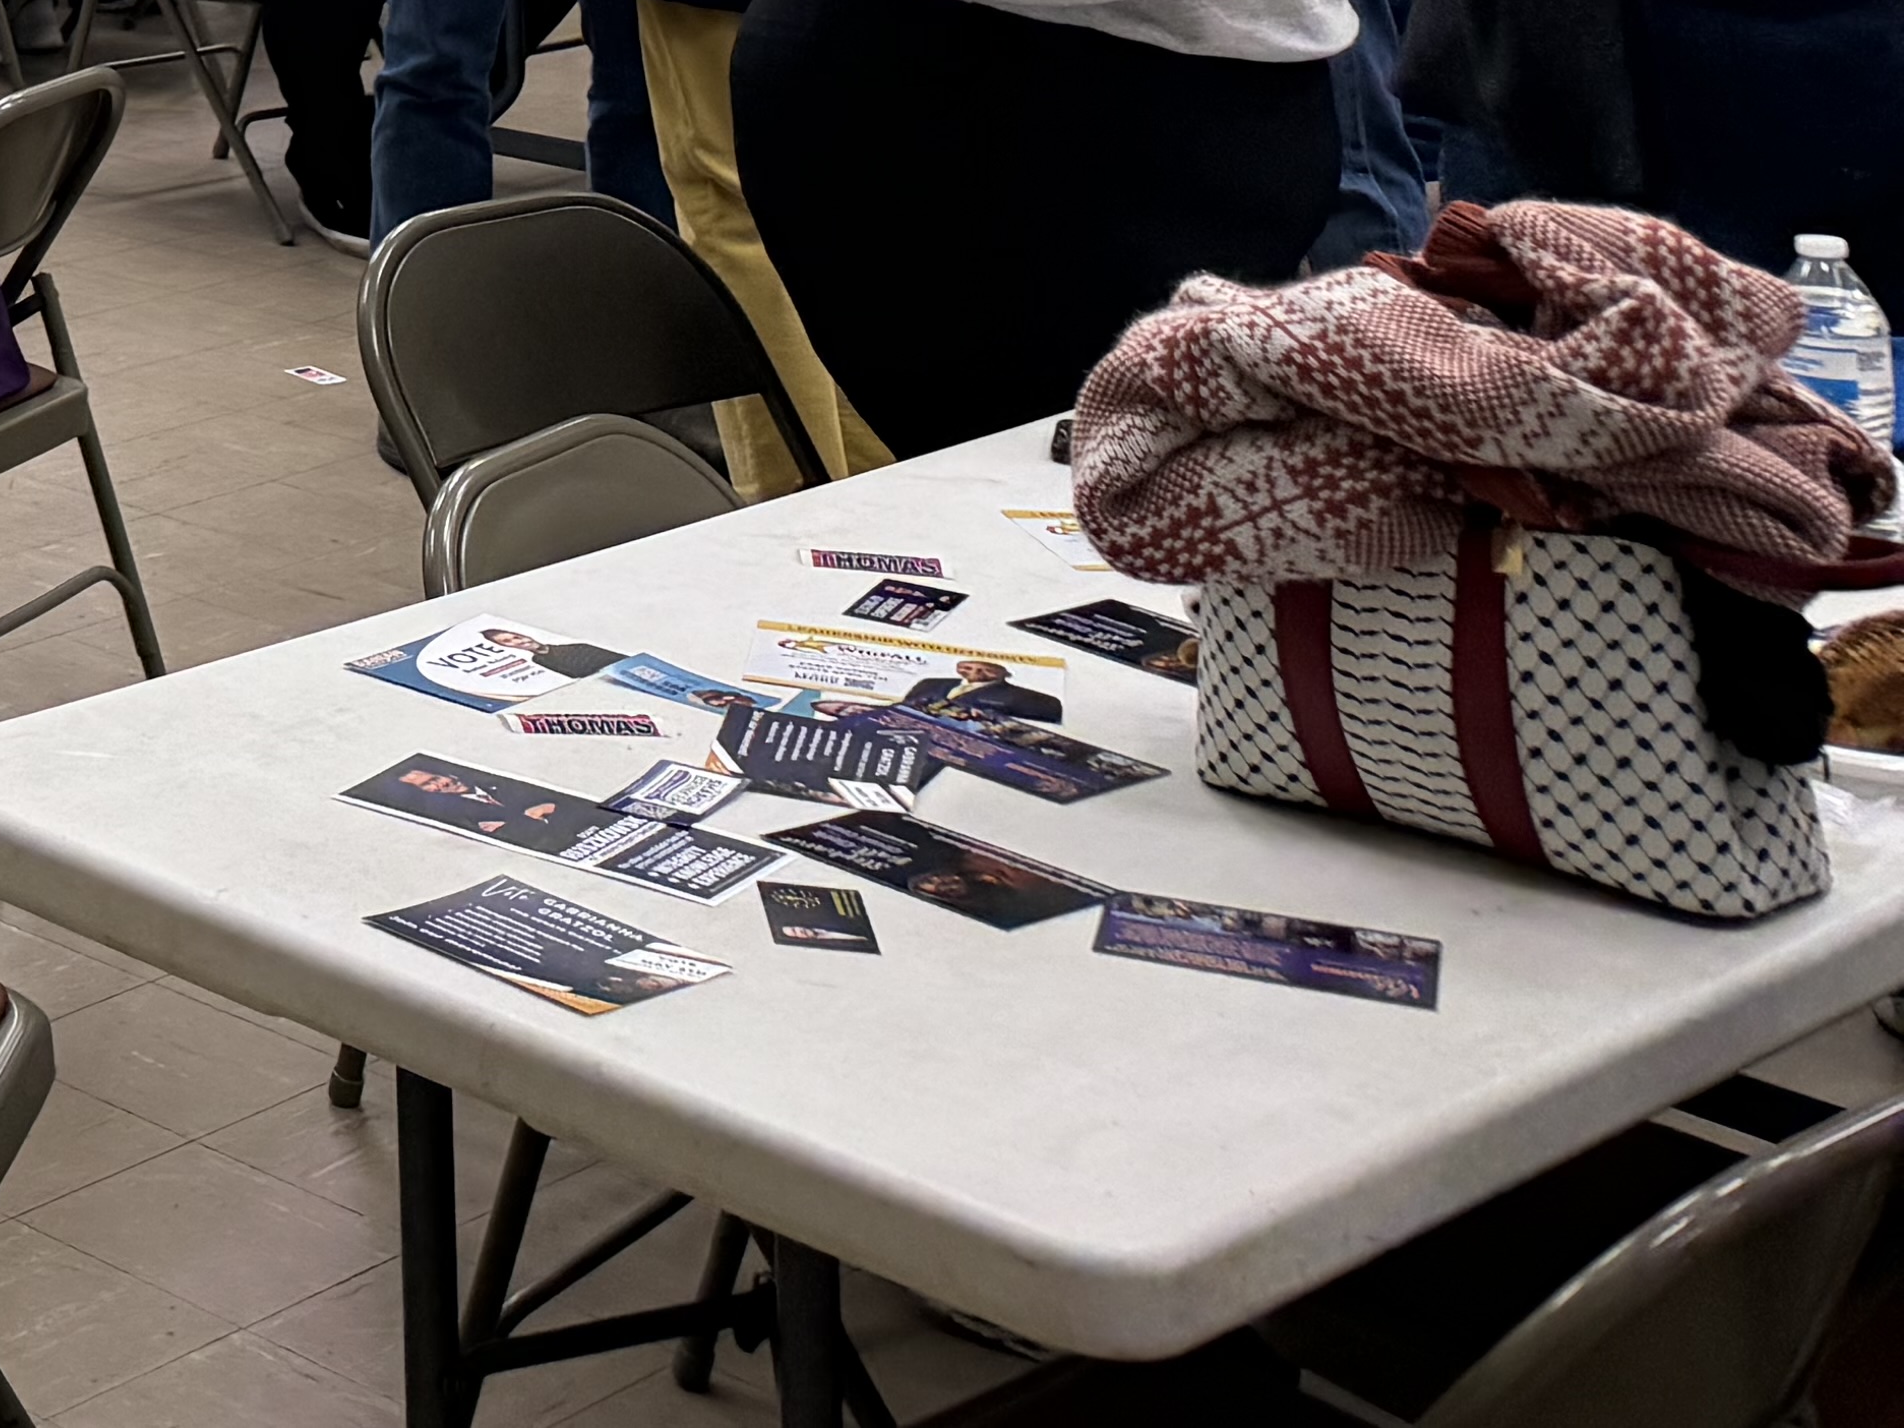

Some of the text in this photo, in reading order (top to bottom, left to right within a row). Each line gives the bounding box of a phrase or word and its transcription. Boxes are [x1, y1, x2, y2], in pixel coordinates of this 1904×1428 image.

[818, 550, 940, 575] THOMAS
[426, 642, 505, 669] VOTE
[530, 713, 653, 736] THOMAS
[537, 907, 614, 943] GRATZOL
[542, 897, 643, 942] GABRIANNA
